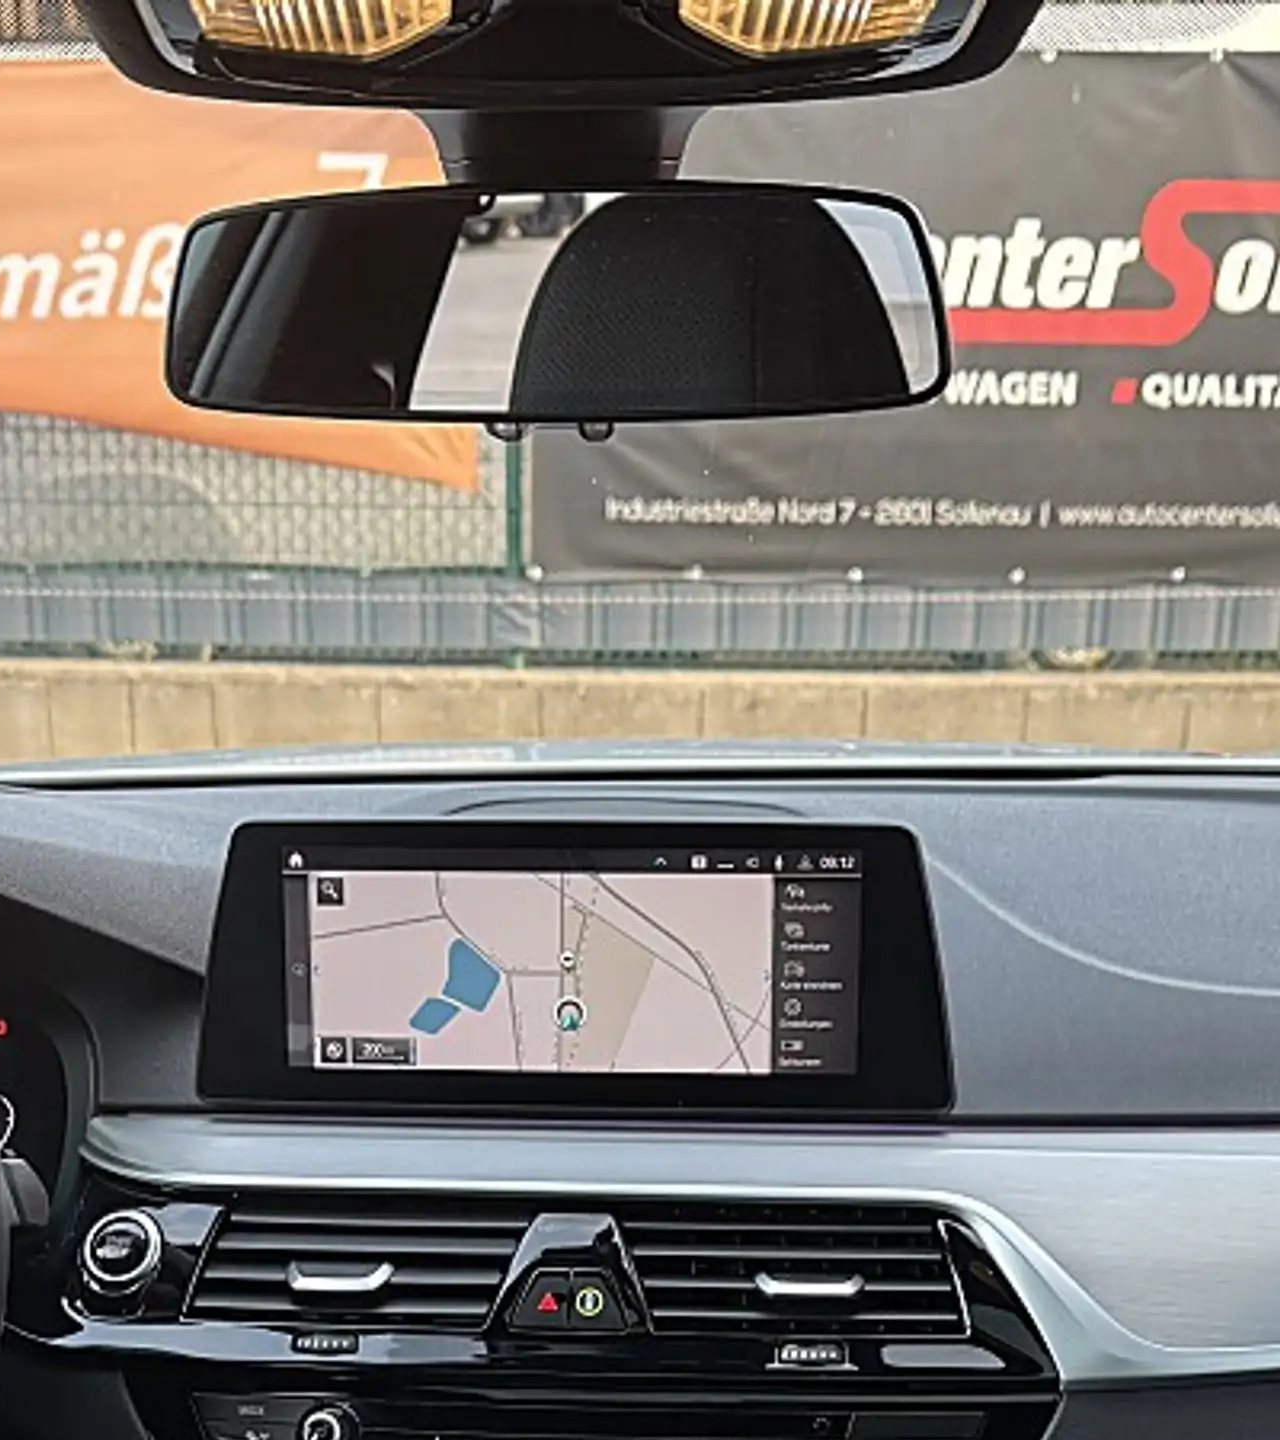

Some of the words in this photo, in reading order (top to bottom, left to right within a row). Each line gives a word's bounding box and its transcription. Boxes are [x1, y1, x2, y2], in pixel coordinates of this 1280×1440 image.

[604, 496, 775, 524] Industriestraße
[777, 496, 837, 525] Nord
[838, 497, 857, 526] 7
[934, 497, 1033, 528] Sollenau
